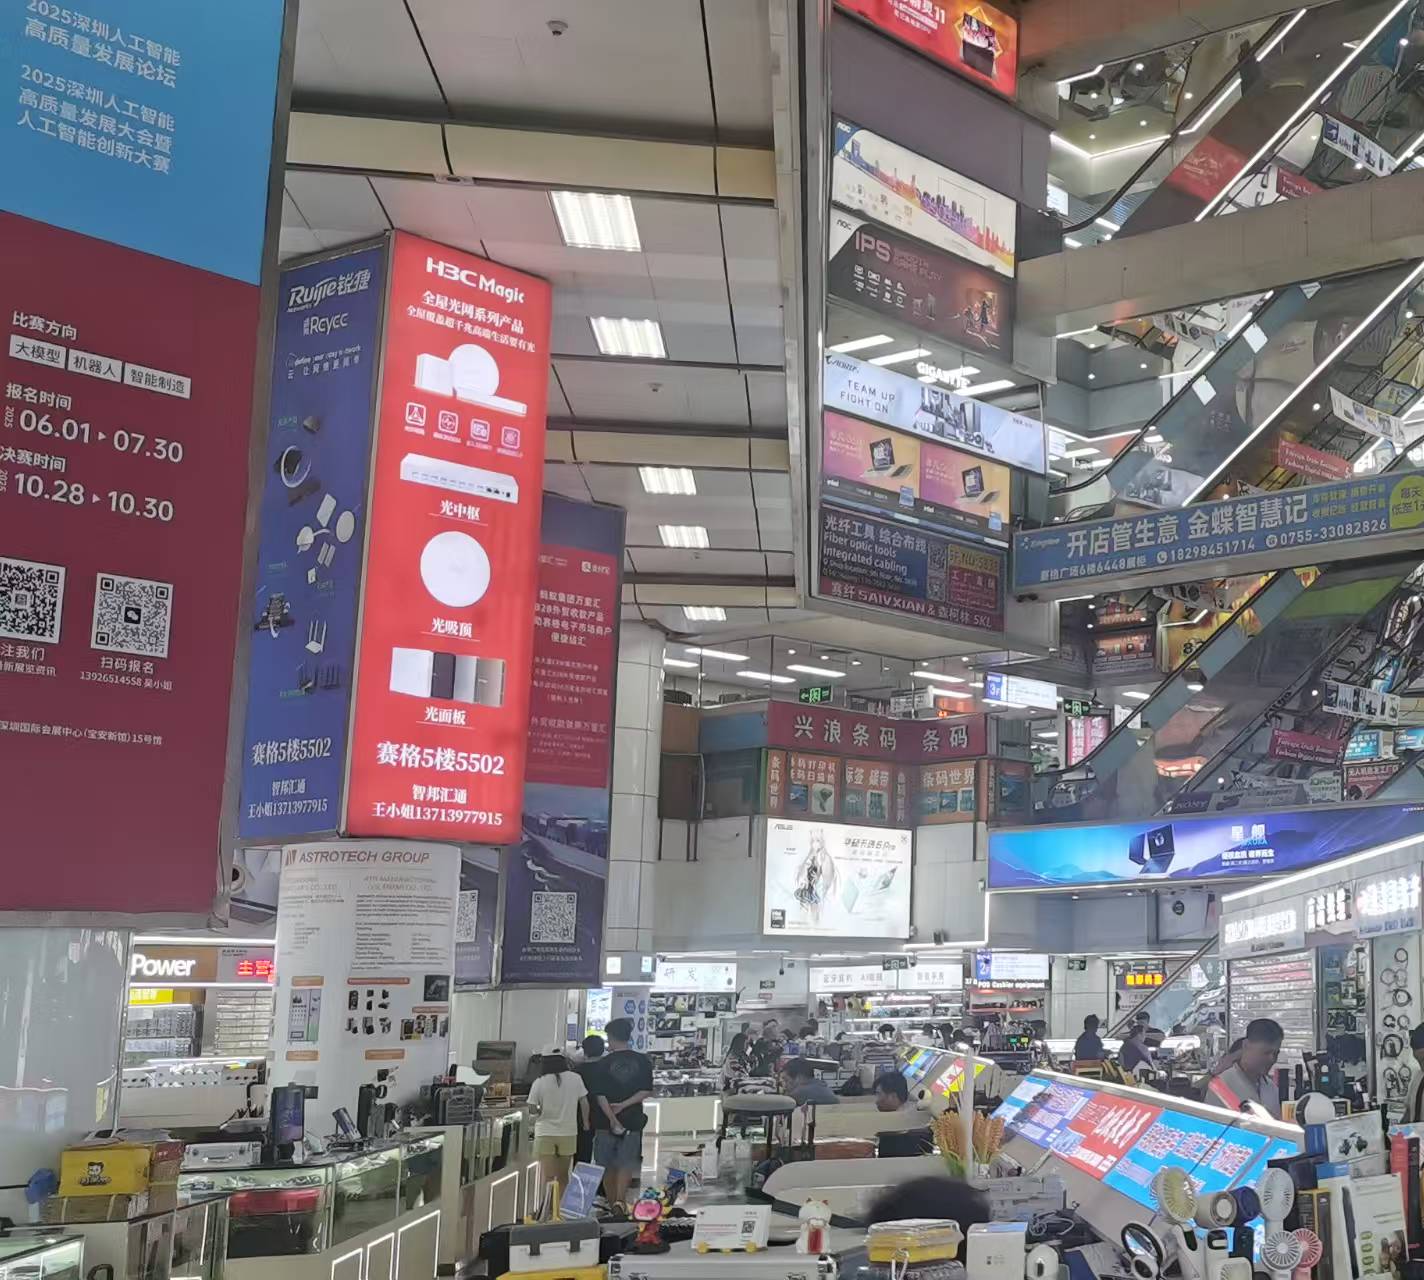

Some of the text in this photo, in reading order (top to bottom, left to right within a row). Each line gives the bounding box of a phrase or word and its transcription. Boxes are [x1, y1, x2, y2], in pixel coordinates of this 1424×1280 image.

[26, 0, 181, 66] 2025深圳人工智能
[24, 17, 176, 88] 高质量发展论坛
[21, 64, 175, 131] 2025深圳人工智能
[18, 87, 172, 154] 高质量发展大会暨
[17, 110, 170, 175] 人工智能创新大赛
[856, 231, 891, 262] IPS
[426, 256, 524, 303] H3C Magic
[12, 311, 77, 341] 比赛方向
[423, 290, 524, 334] 全屋光网系列产品
[15, 341, 185, 394] 大模型 机器人 智能制造
[5, 382, 72, 411] 报名时间
[840, 392, 889, 414] FIGHT ON
[848, 380, 895, 400] TEAM UP
[20, 409, 183, 463] 06.01 07.30
[15, 473, 174, 521] 10.28 10.30
[440, 500, 480, 520] 光中枢
[825, 515, 875, 542] 光纤工具
[1066, 494, 1308, 559] 开店管生意 金蝶智慧记
[1170, 537, 1255, 562] 18298451714
[1281, 518, 1387, 547] 0755-33082826
[824, 531, 897, 558] Fiber optic tools
[874, 557, 907, 576] cabling
[431, 618, 472, 638] 光吸顶
[974, 614, 992, 628] SKL
[0, 660, 57, 677] 新展览资讯
[100, 656, 154, 674] 扫码报名
[424, 706, 466, 726] 光面板
[794, 715, 968, 752] 兴浪条码 条码
[252, 737, 331, 766] 赛格5楼5502
[377, 741, 504, 775] 赛格5楼5502
[412, 784, 467, 805] 智邦汇通
[371, 801, 503, 826] 王小姐13713977915
[300, 851, 430, 864] ASTROTECH GROUP
[131, 954, 196, 977] Power
